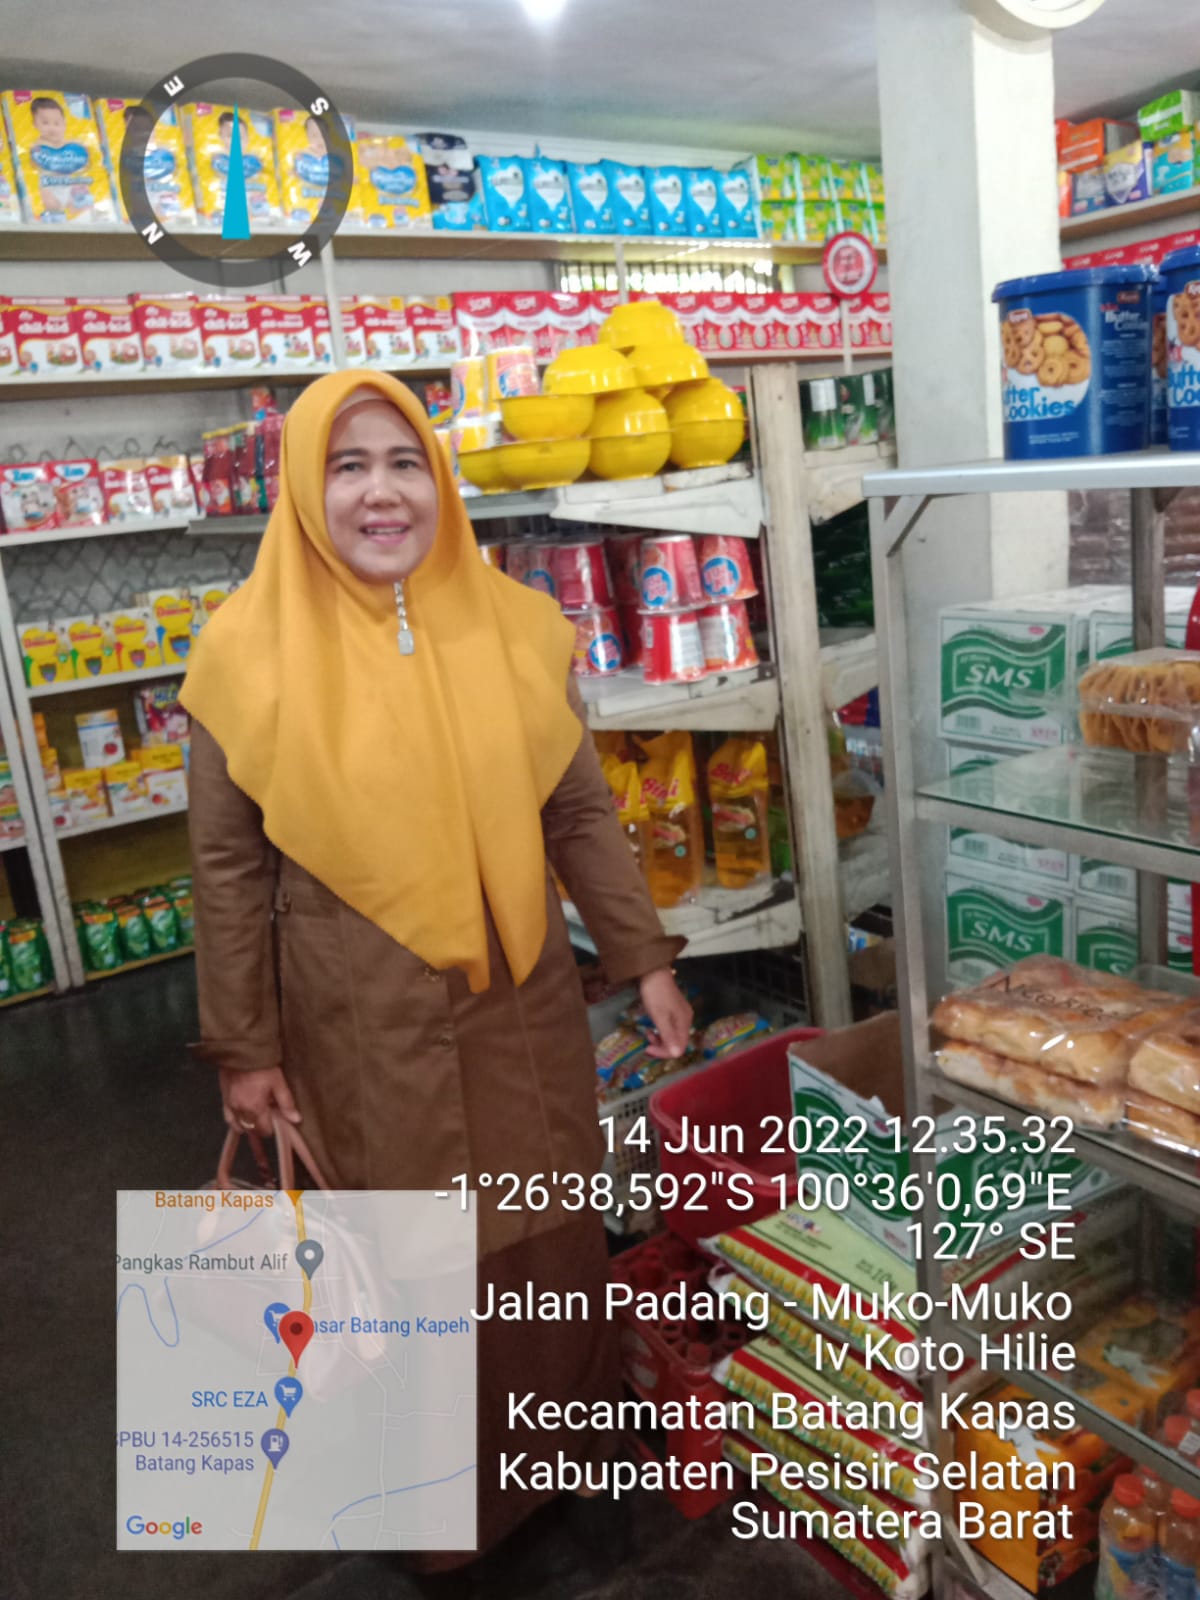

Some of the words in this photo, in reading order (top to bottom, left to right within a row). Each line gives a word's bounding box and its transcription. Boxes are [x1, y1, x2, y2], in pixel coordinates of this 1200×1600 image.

[1006, 396, 1076, 420] ookies
[965, 664, 1034, 689] SMS
[970, 920, 1036, 952] SMS
